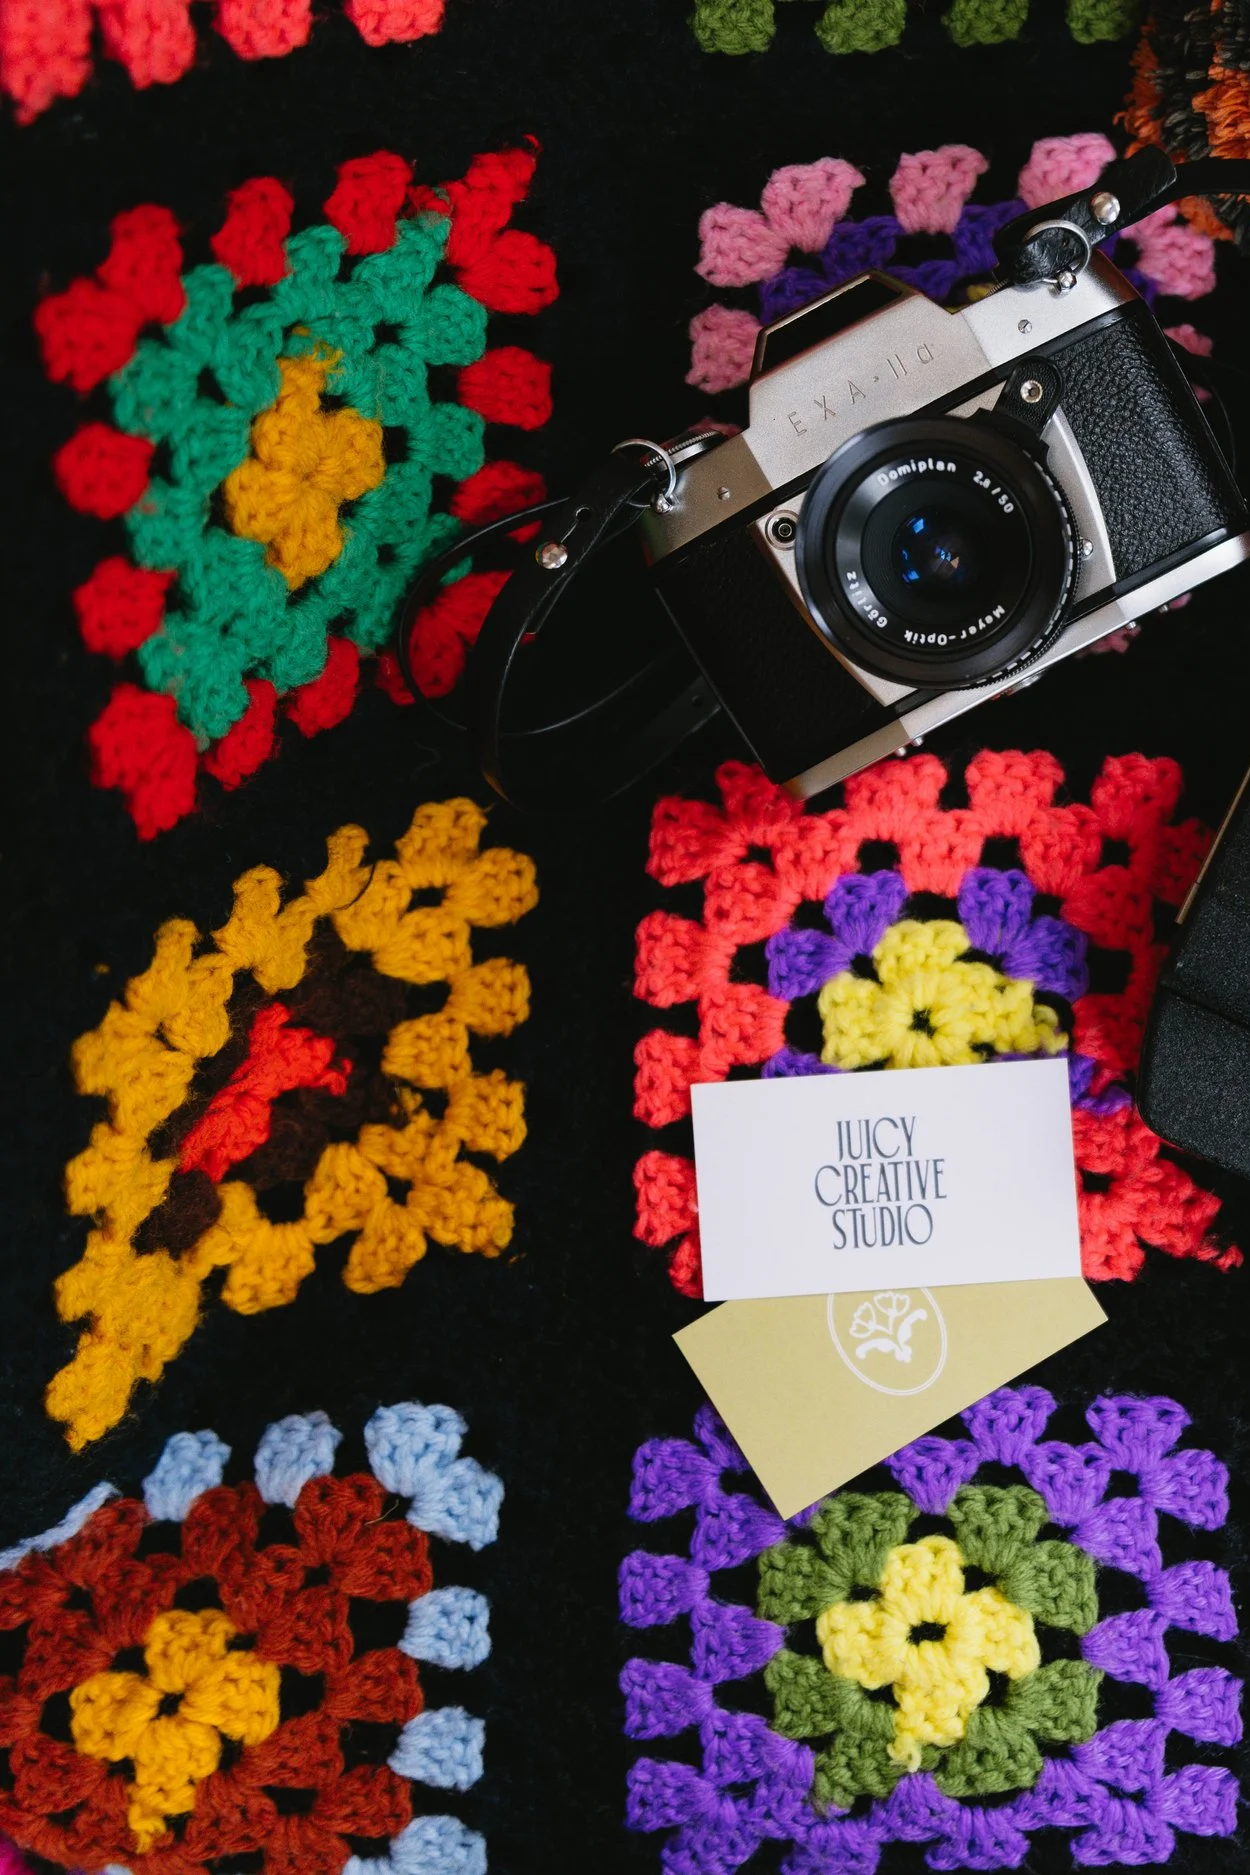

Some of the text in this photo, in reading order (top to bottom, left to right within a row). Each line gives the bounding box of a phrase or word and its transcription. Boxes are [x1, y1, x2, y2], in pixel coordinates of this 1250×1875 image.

[876, 457, 957, 487] Domiplan
[846, 571, 1006, 646] Meyer-Optik Görlitz
[836, 1116, 916, 1162] JUICY
[814, 1158, 948, 1207] CREATIVE
[832, 1203, 934, 1251] STUDIO
